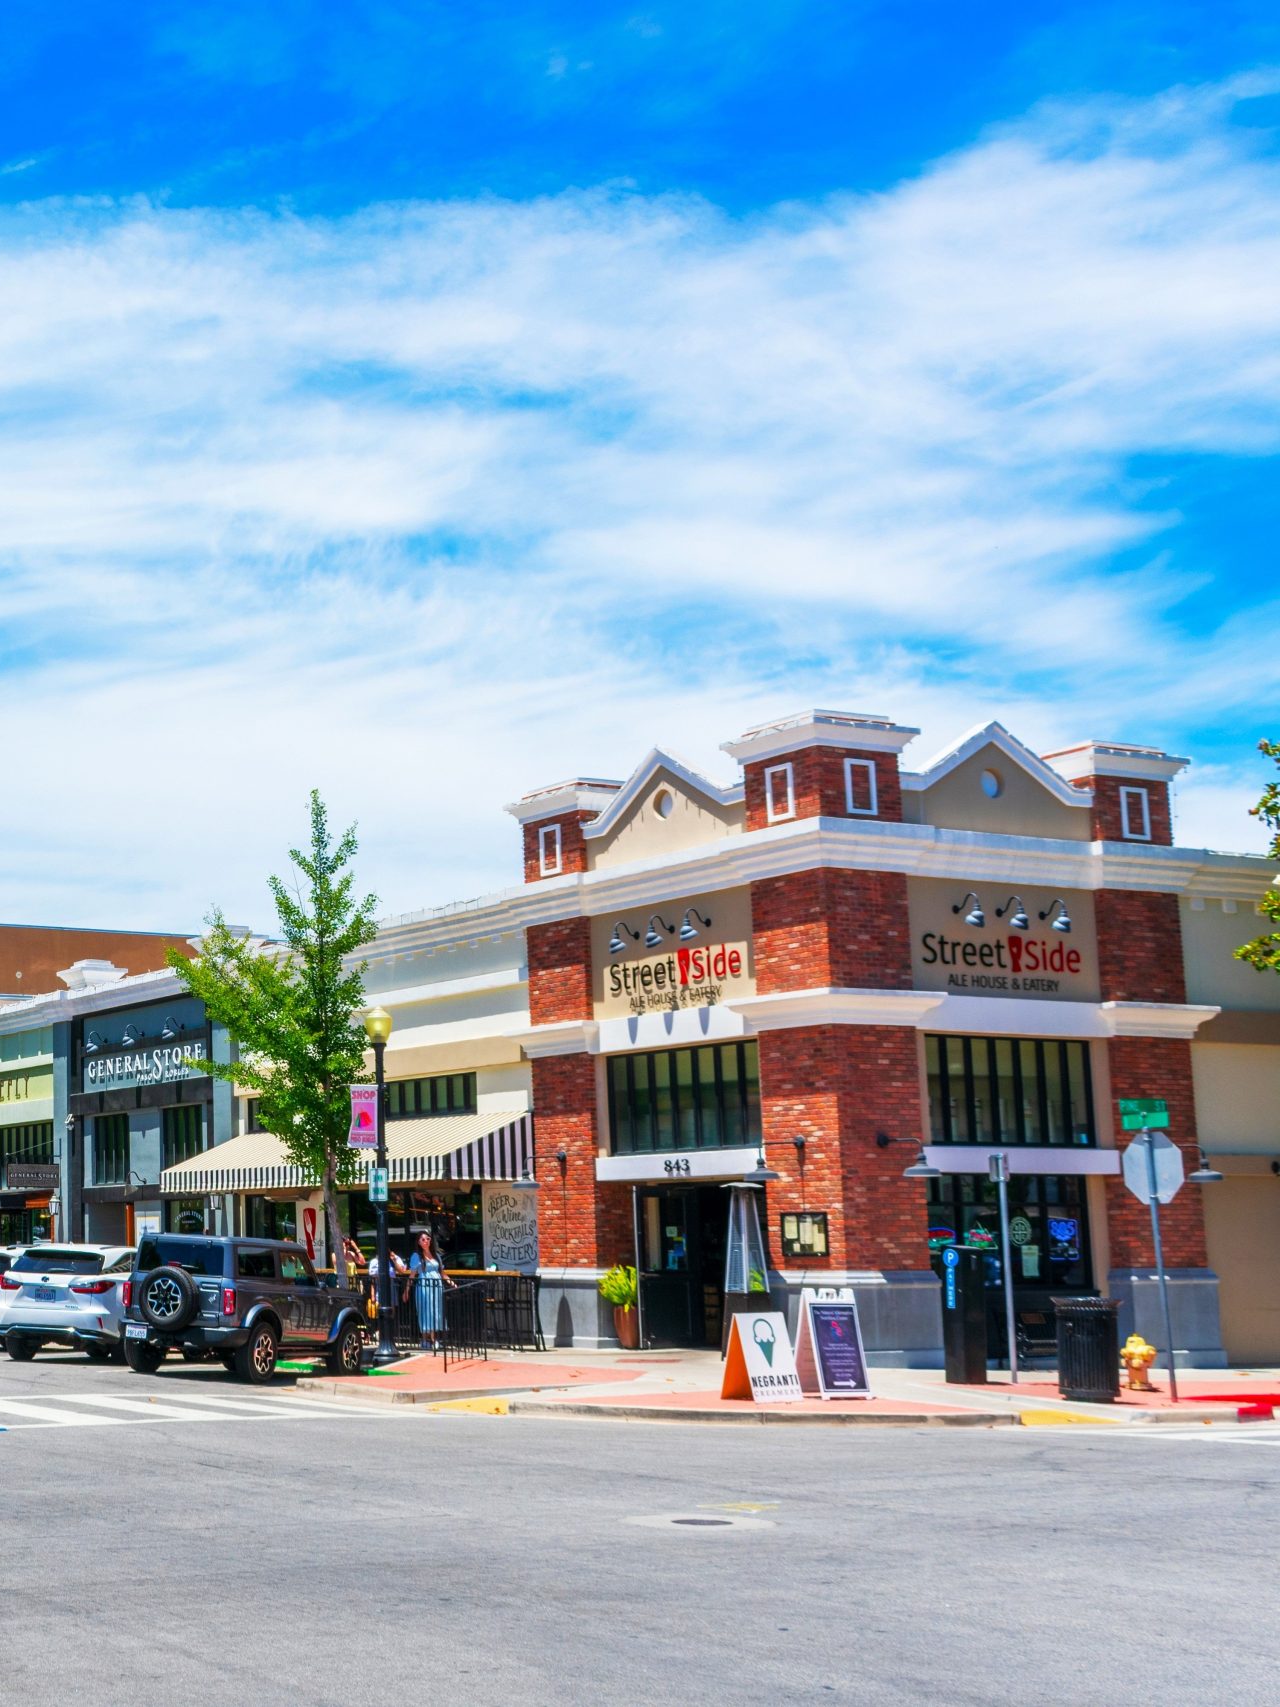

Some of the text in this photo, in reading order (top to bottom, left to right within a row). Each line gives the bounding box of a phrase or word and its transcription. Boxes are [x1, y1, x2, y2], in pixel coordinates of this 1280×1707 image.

[922, 933, 1081, 973] Street Side
[609, 943, 741, 992] Street Side
[948, 974, 1060, 992] ALE HOUSE & EATERY
[629, 984, 721, 1008] ALE HOUSE & EATERY
[88, 1043, 203, 1079] GENERAL STORE
[136, 1067, 189, 1082] PASO ROBLES
[351, 1090, 376, 1100] SHOP
[664, 1158, 690, 1173] 843
[947, 1252, 954, 1263] P
[751, 1375, 799, 1388] NEGRANTI
[753, 1389, 800, 1398] CREAMERY
